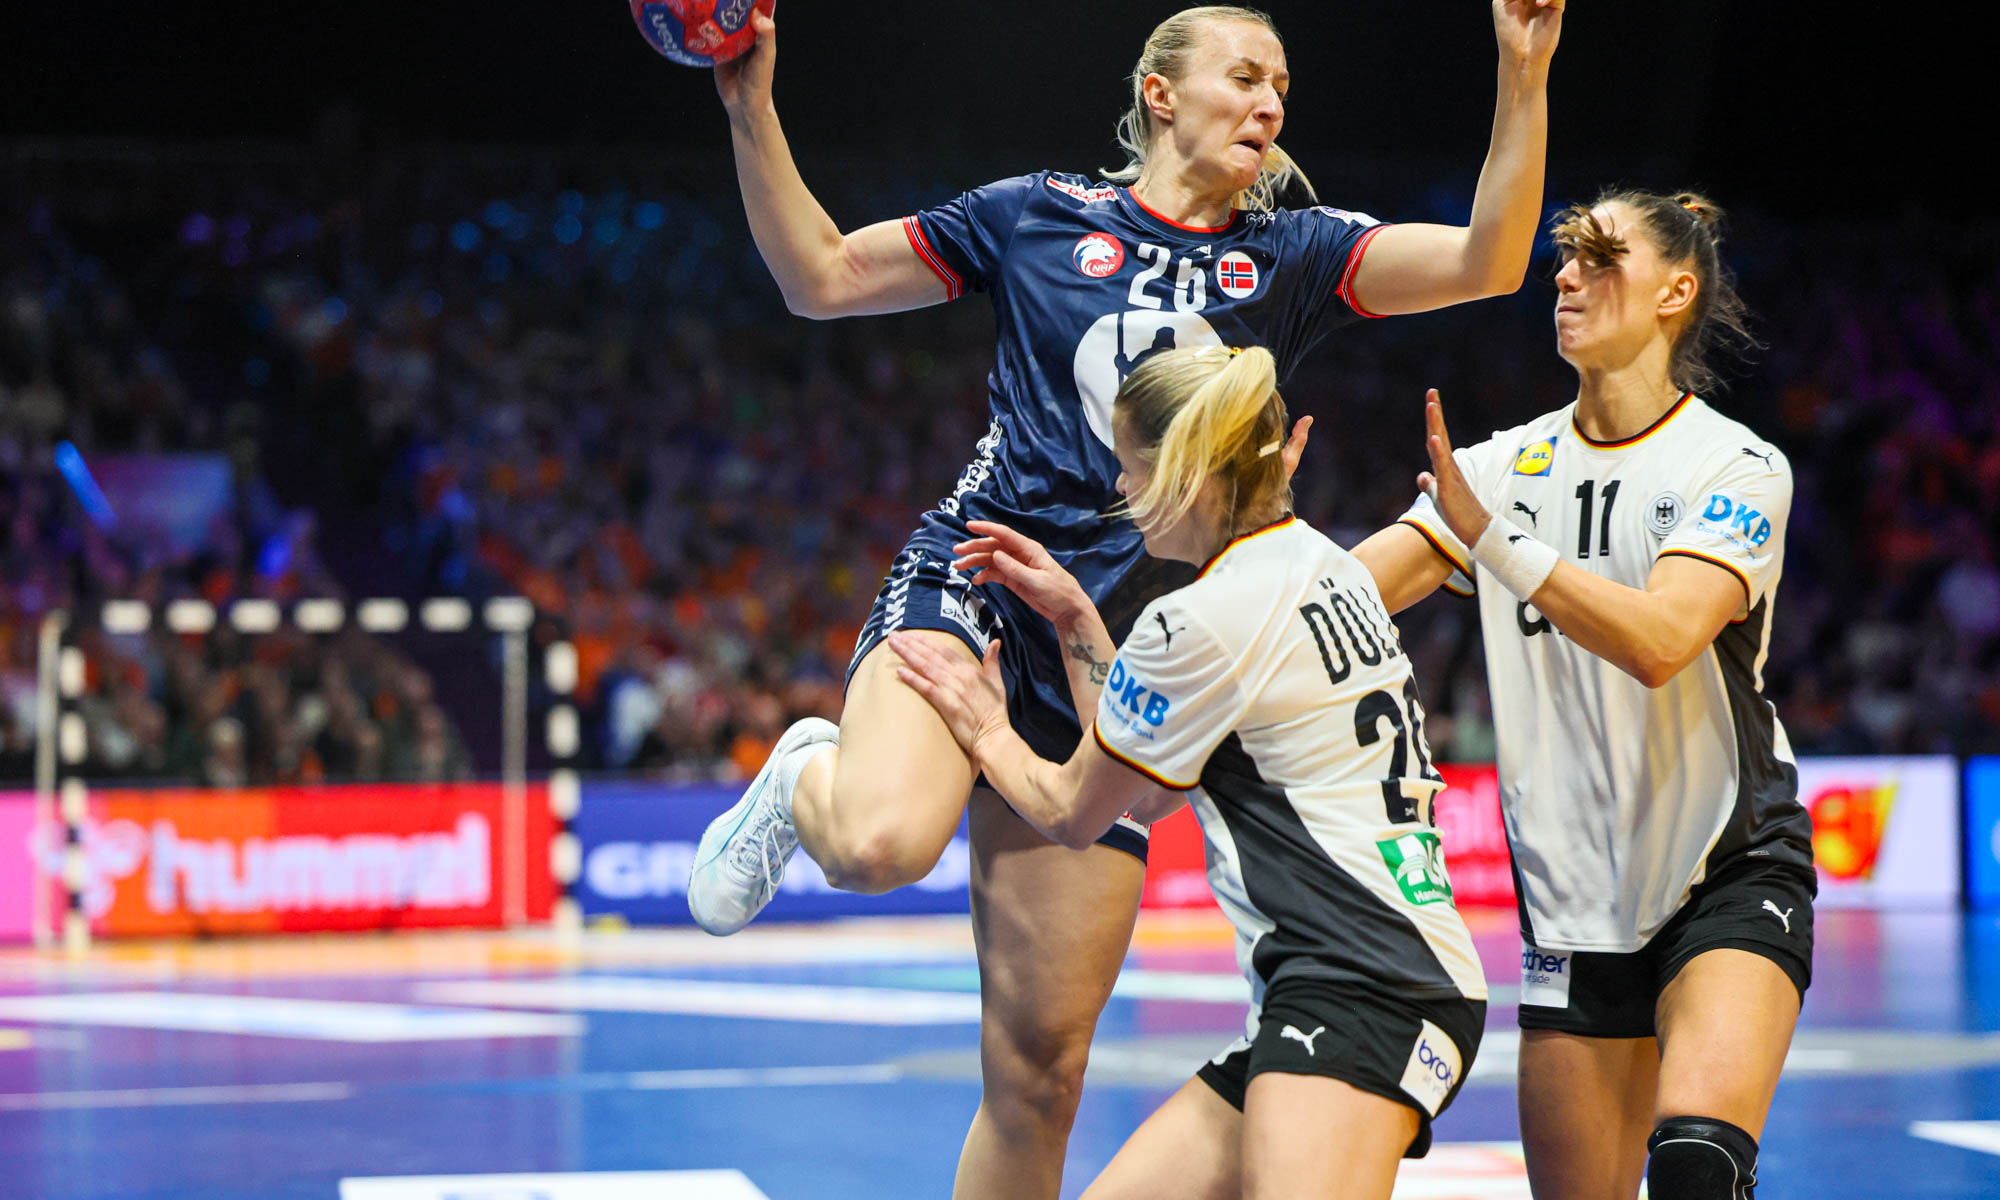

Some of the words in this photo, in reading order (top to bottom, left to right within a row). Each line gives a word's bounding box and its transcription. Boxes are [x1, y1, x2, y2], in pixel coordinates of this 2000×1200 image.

[1092, 263, 1116, 273] NHF
[1127, 241, 1207, 313] 26
[1575, 479, 1621, 559] 11
[1702, 494, 1771, 548] DKB
[1109, 659, 1170, 727] DKB
